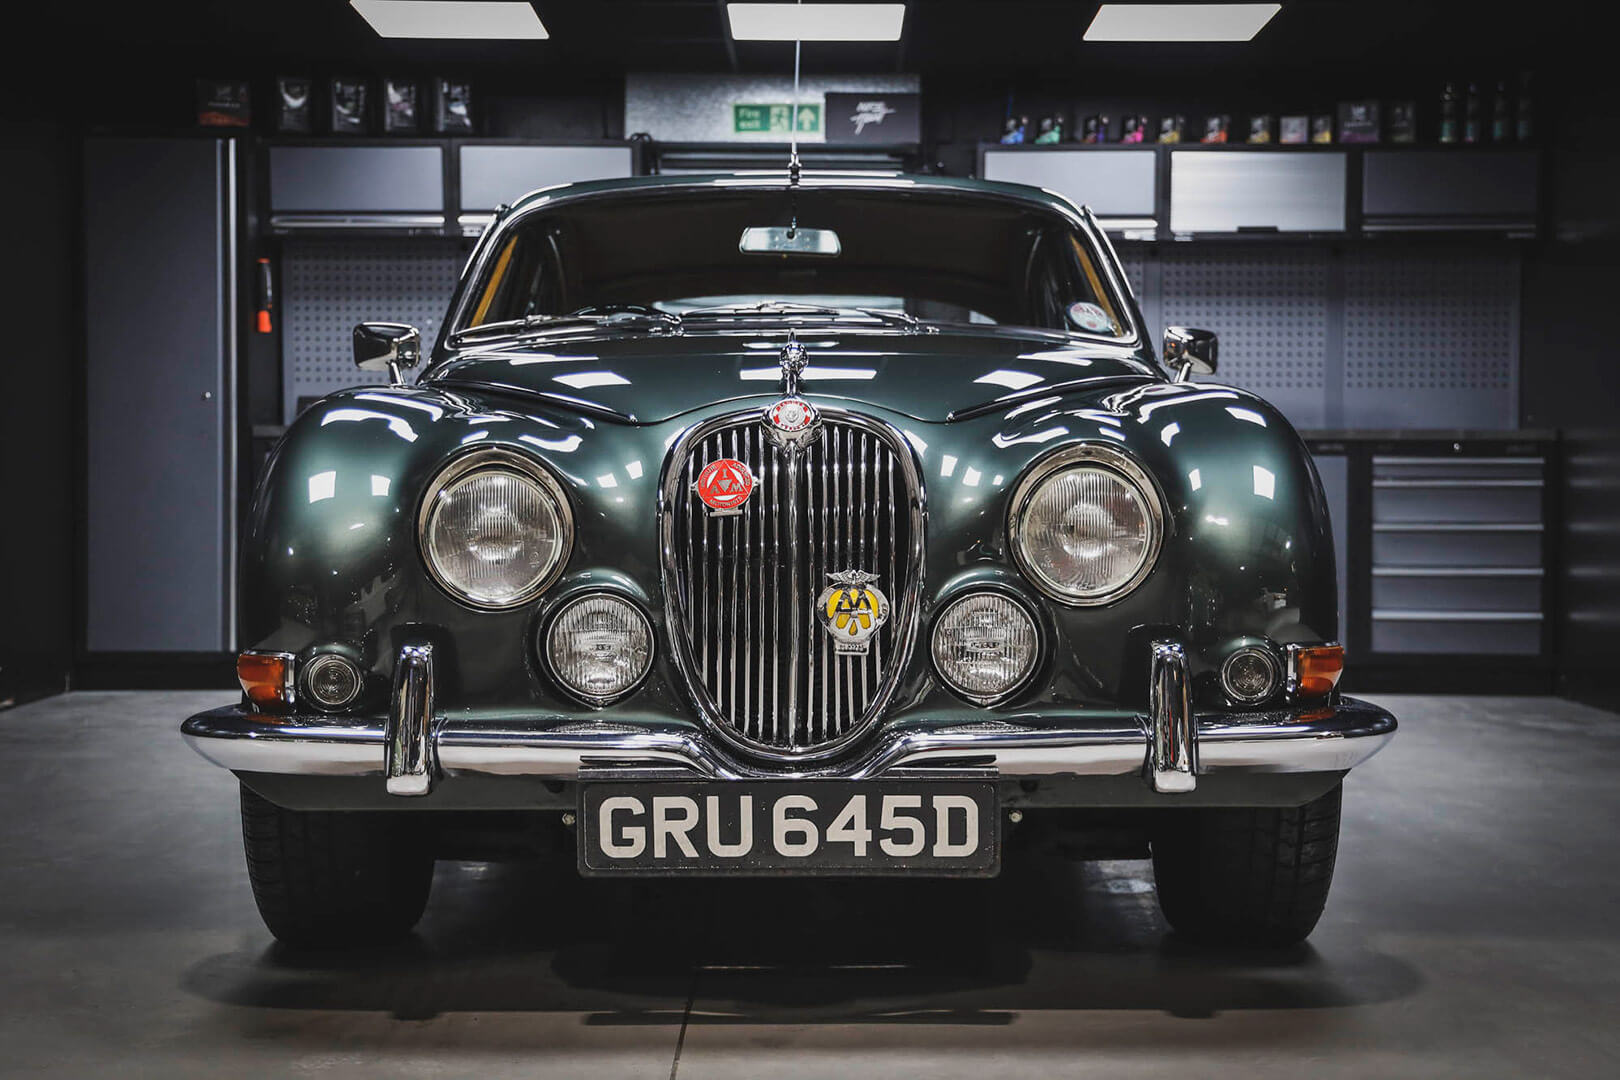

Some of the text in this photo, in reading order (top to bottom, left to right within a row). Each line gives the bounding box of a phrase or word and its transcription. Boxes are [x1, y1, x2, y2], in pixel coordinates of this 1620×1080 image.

[738, 107, 760, 119] Fire
[738, 119, 760, 129] exit
[600, 796, 979, 858] GRU 645D
